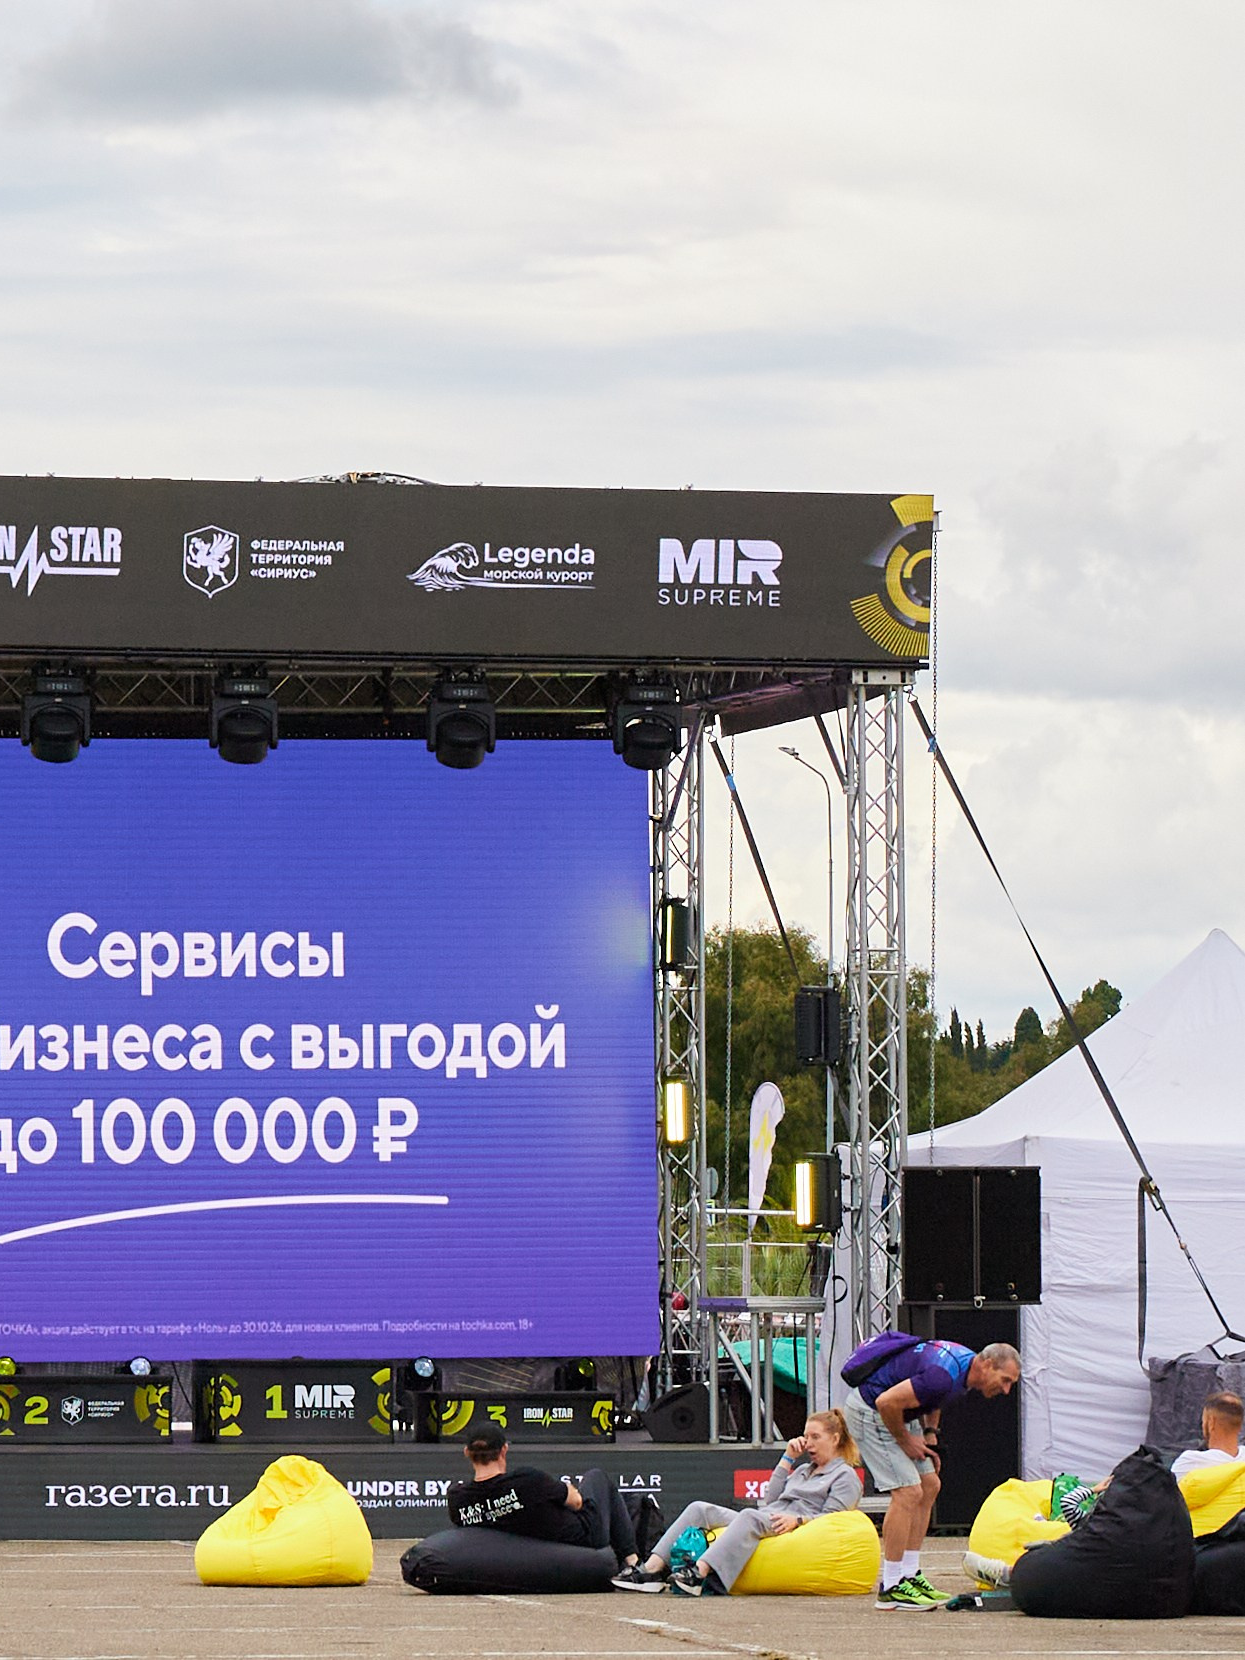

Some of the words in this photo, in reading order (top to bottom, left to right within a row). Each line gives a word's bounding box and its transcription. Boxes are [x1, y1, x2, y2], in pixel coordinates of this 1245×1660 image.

[50, 526, 122, 563] STAR
[250, 539, 345, 552] ФЕДЕРАЛЬНАЯ
[250, 553, 333, 566] ТЕРРИТОРИЯ
[483, 542, 596, 569] Legenda
[658, 537, 784, 586] MIR
[250, 567, 317, 580] «СИРИУС»
[483, 567, 544, 582] морской
[546, 570, 595, 583] курорт
[658, 588, 781, 607] SUPREME
[47, 911, 345, 996] Сервисы
[240, 1022, 275, 1071] с
[292, 1004, 567, 1078] выгодой
[72, 1096, 196, 1165] 100
[213, 1096, 358, 1165] 000
[229, 1323, 242, 1334] до
[265, 1384, 288, 1419] 1
[294, 1384, 356, 1409] MIR
[24, 1395, 49, 1425] 2
[294, 1409, 355, 1419] SUPREME
[523, 1407, 544, 1419] IRON
[551, 1407, 574, 1419] STAR
[45, 1483, 232, 1508] газета.ru
[425, 1480, 452, 1496] BY
[493, 1488, 519, 1508] need
[395, 1498, 449, 1508] ОЛИМПИ
